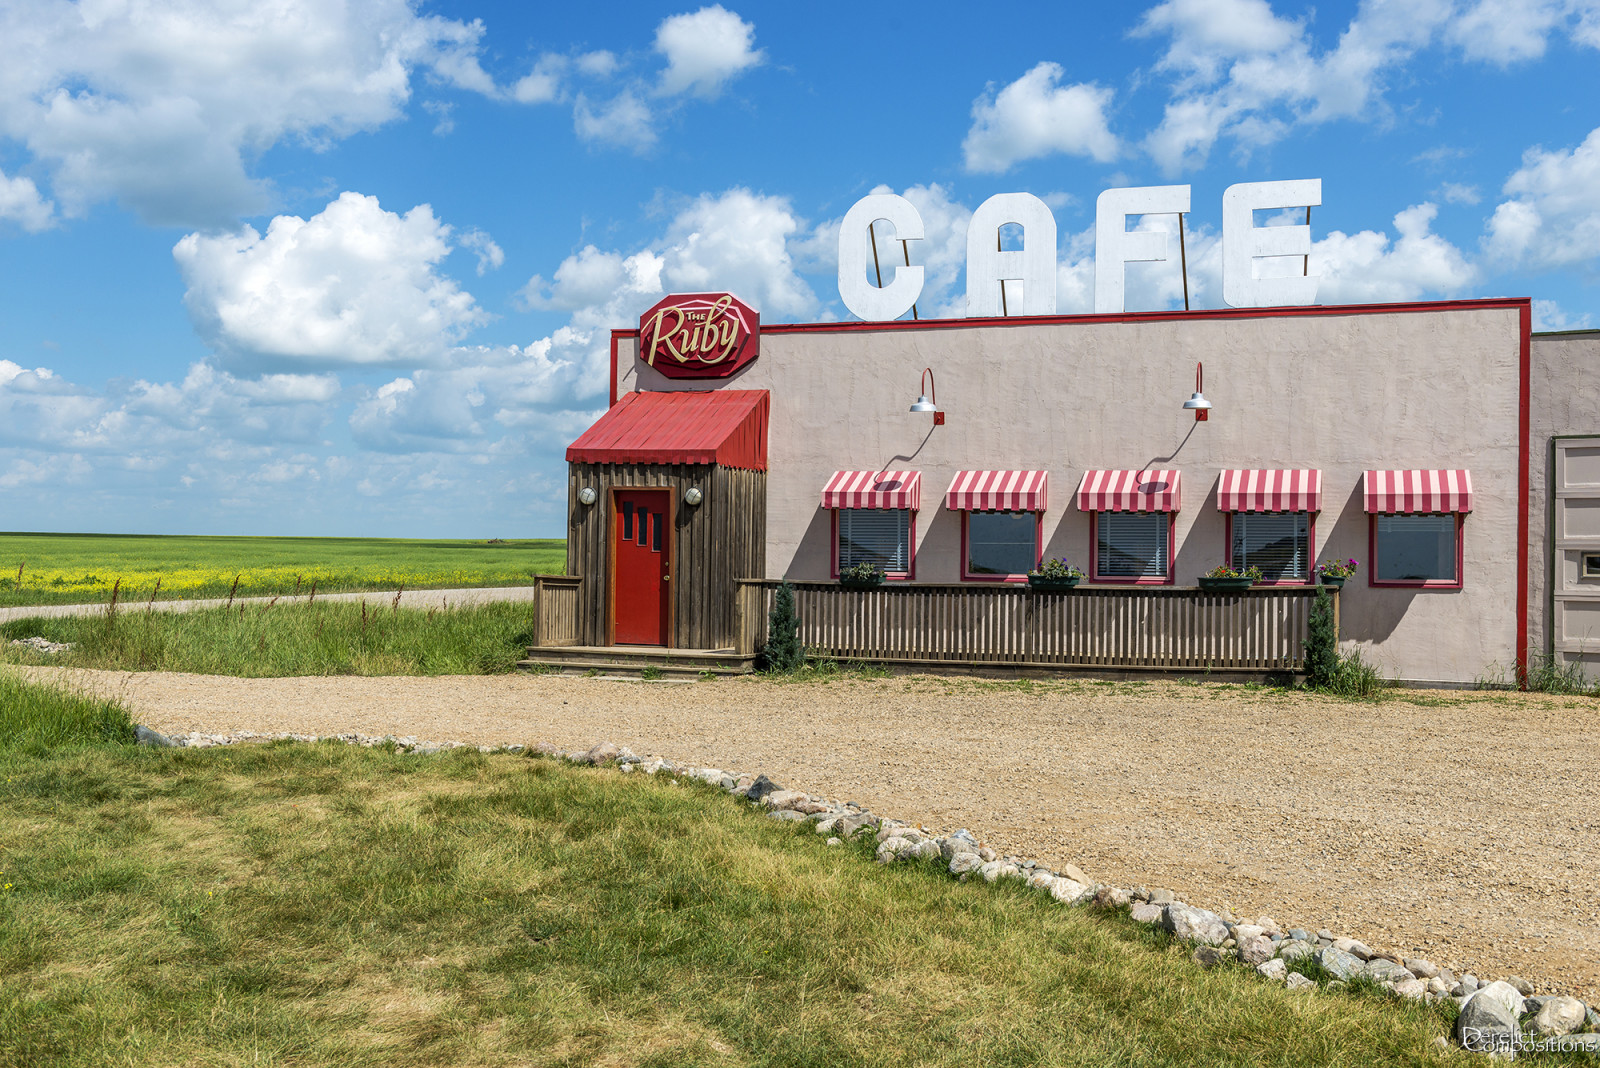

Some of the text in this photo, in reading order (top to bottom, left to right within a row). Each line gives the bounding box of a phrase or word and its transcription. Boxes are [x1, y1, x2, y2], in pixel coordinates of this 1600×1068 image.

[838, 178, 1322, 321] CAFE
[640, 295, 739, 366] Ruby
[686, 311, 706, 321] THE
